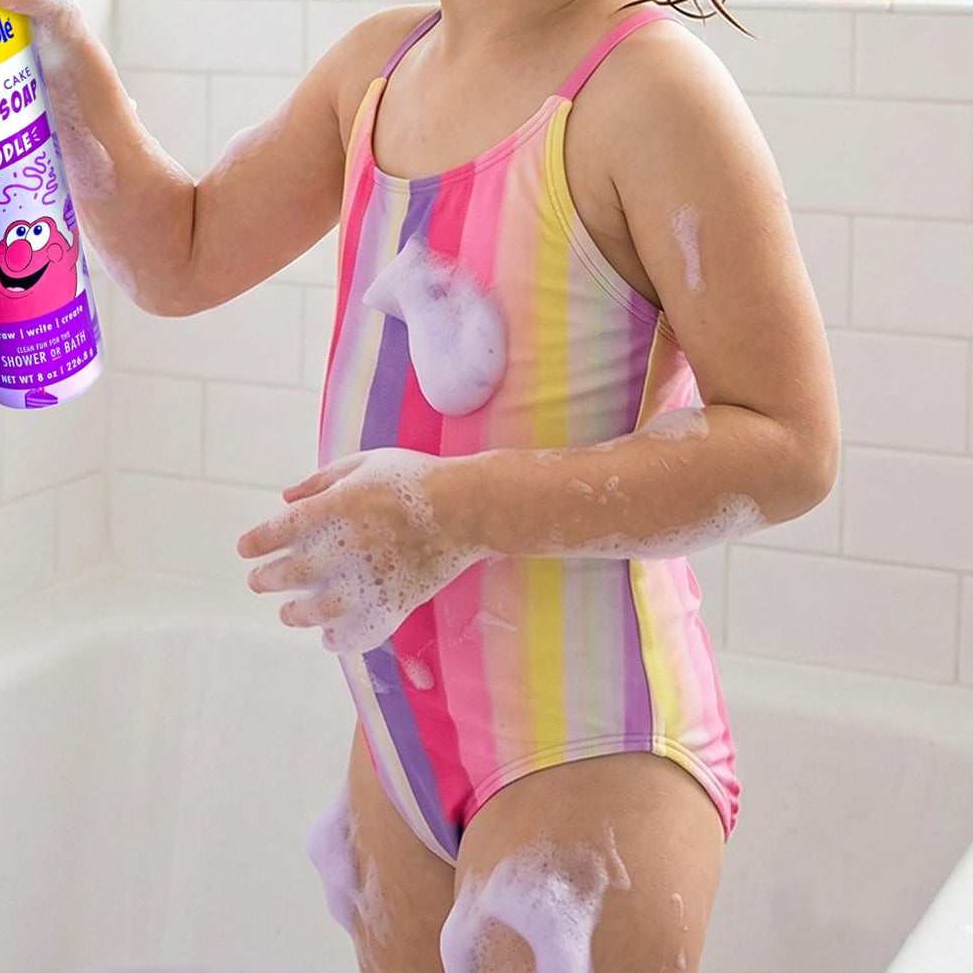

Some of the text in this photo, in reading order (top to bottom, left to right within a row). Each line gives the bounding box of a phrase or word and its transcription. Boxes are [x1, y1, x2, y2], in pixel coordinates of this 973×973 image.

[3, 66, 32, 90] CAKE
[26, 324, 53, 337] write
[61, 305, 83, 324] create
[1, 330, 87, 368] SHOWER OR BATH
[16, 344, 35, 354] CLEAN
[49, 337, 60, 346] FOR
[1, 374, 16, 384] NET
[19, 374, 34, 384] WT
[37, 373, 44, 382] 8
